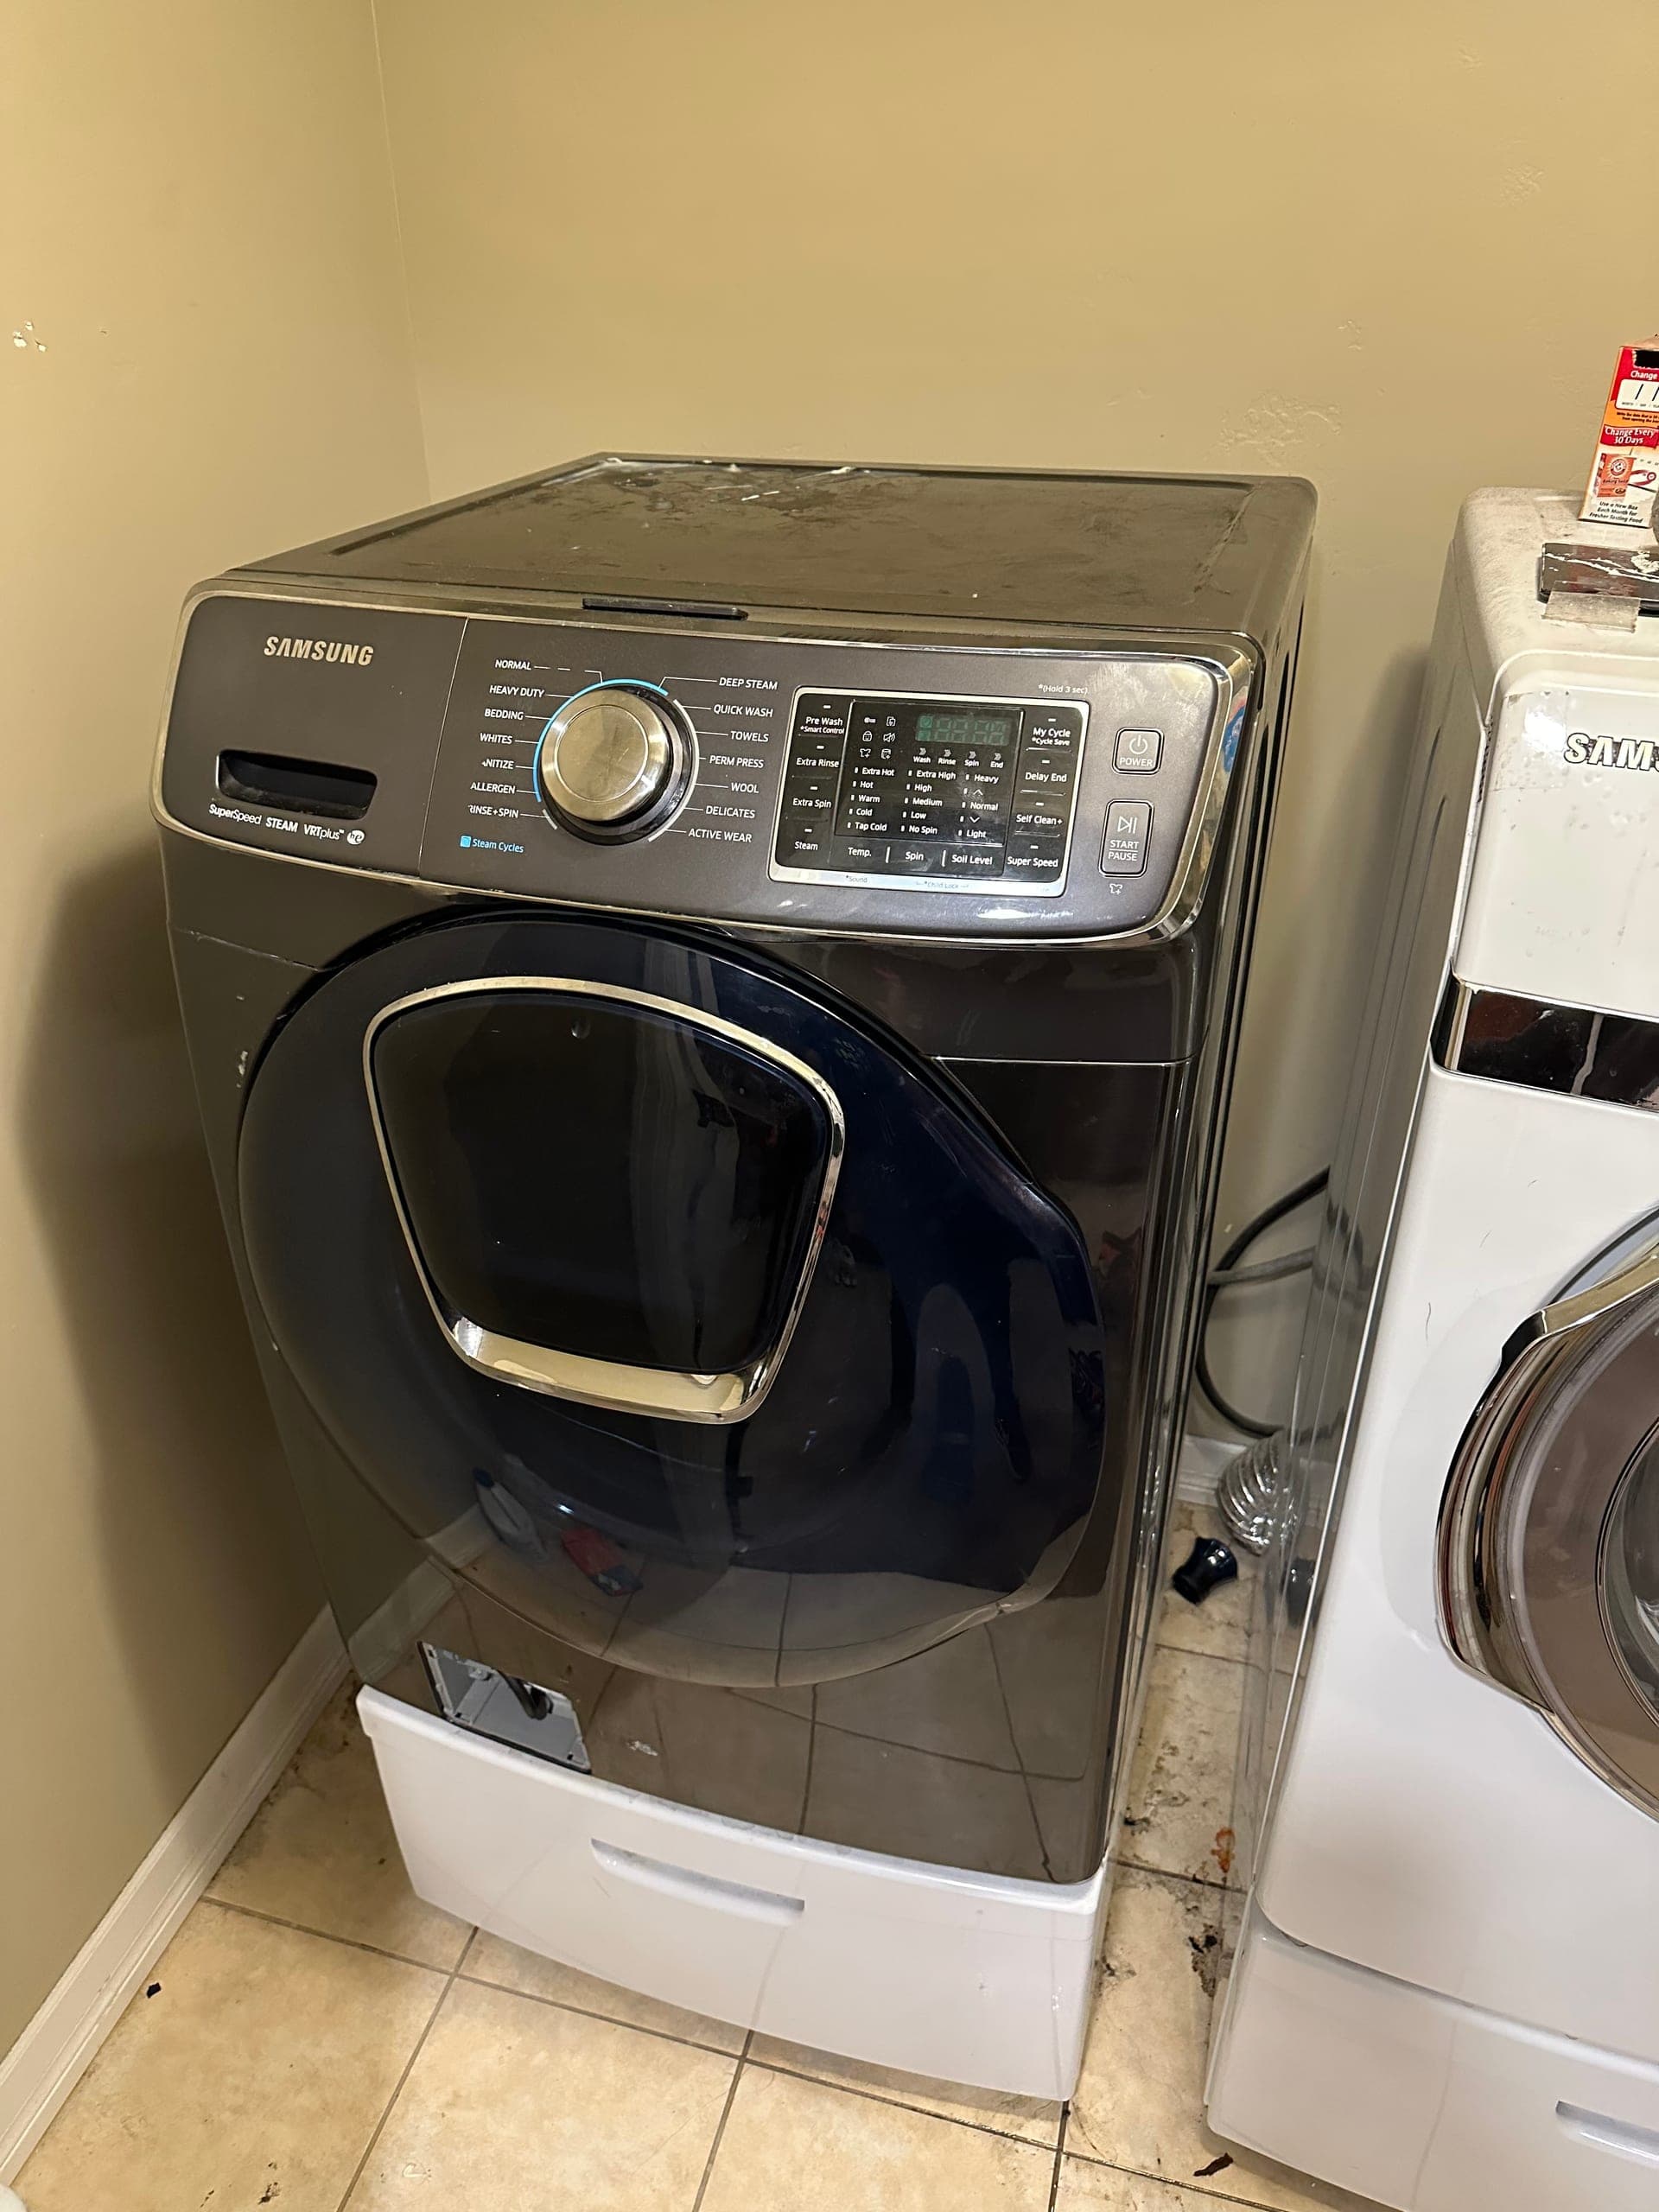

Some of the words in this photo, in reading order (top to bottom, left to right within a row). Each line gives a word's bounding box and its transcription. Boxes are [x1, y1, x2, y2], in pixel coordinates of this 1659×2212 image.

[1630, 371, 1657, 380] Change
[1605, 428, 1631, 437] Change
[1634, 429, 1655, 438] Every
[1624, 436, 1643, 446] Days
[264, 636, 373, 665] SAMSUNG
[495, 659, 531, 671] NORMAL
[719, 677, 744, 687] DEEP
[745, 679, 778, 690] STEAM
[489, 685, 518, 696] HEAVY
[520, 688, 544, 698] DUTY
[1072, 686, 1088, 695] sec)
[485, 709, 524, 720] BEDDING
[714, 704, 743, 715] QUICK
[745, 707, 773, 717] WASH
[805, 716, 820, 726] Pre
[821, 717, 843, 726] Wash
[731, 731, 769, 742] TOWELS
[1033, 728, 1047, 737] My
[1048, 728, 1071, 738] Cycle
[480, 733, 512, 744] WHITES
[1563, 732, 1659, 772] SAM
[709, 755, 734, 766] PERM
[736, 757, 764, 768] PRESS
[796, 758, 817, 766] Extra
[818, 759, 840, 767] Rinse
[1119, 757, 1154, 767] POWER
[938, 772, 957, 780] High
[974, 774, 999, 784] Heavy
[1025, 772, 1048, 783] Delay
[1051, 773, 1067, 782] End
[470, 782, 516, 794] ALLERGEN
[731, 782, 760, 793] WOOL
[914, 784, 932, 792] High
[792, 798, 813, 807] Extra
[814, 799, 831, 809] Spin
[858, 794, 880, 803] Warm
[912, 798, 943, 806] Medium
[970, 802, 998, 810] Normal
[706, 805, 755, 818] DELICATES
[209, 804, 262, 824] SuperSpeed
[265, 817, 299, 832] STEAM
[1016, 814, 1033, 823] Self
[855, 822, 868, 830] Tap
[870, 823, 887, 831] Cold
[921, 826, 938, 835] Spin
[688, 828, 721, 840] ACTIVE
[724, 831, 752, 842] WEAR
[966, 830, 986, 838] Light
[472, 838, 497, 849] Steam
[499, 842, 524, 853] Cycles
[794, 841, 818, 850] Steam
[1109, 839, 1139, 849] START
[848, 847, 872, 857] Temp.
[906, 851, 924, 861] Spin
[1108, 852, 1137, 861] PAUSE
[951, 854, 968, 863] Soil
[969, 855, 993, 865] Level
[1007, 856, 1030, 867] Super
[1033, 857, 1058, 868] Speed
